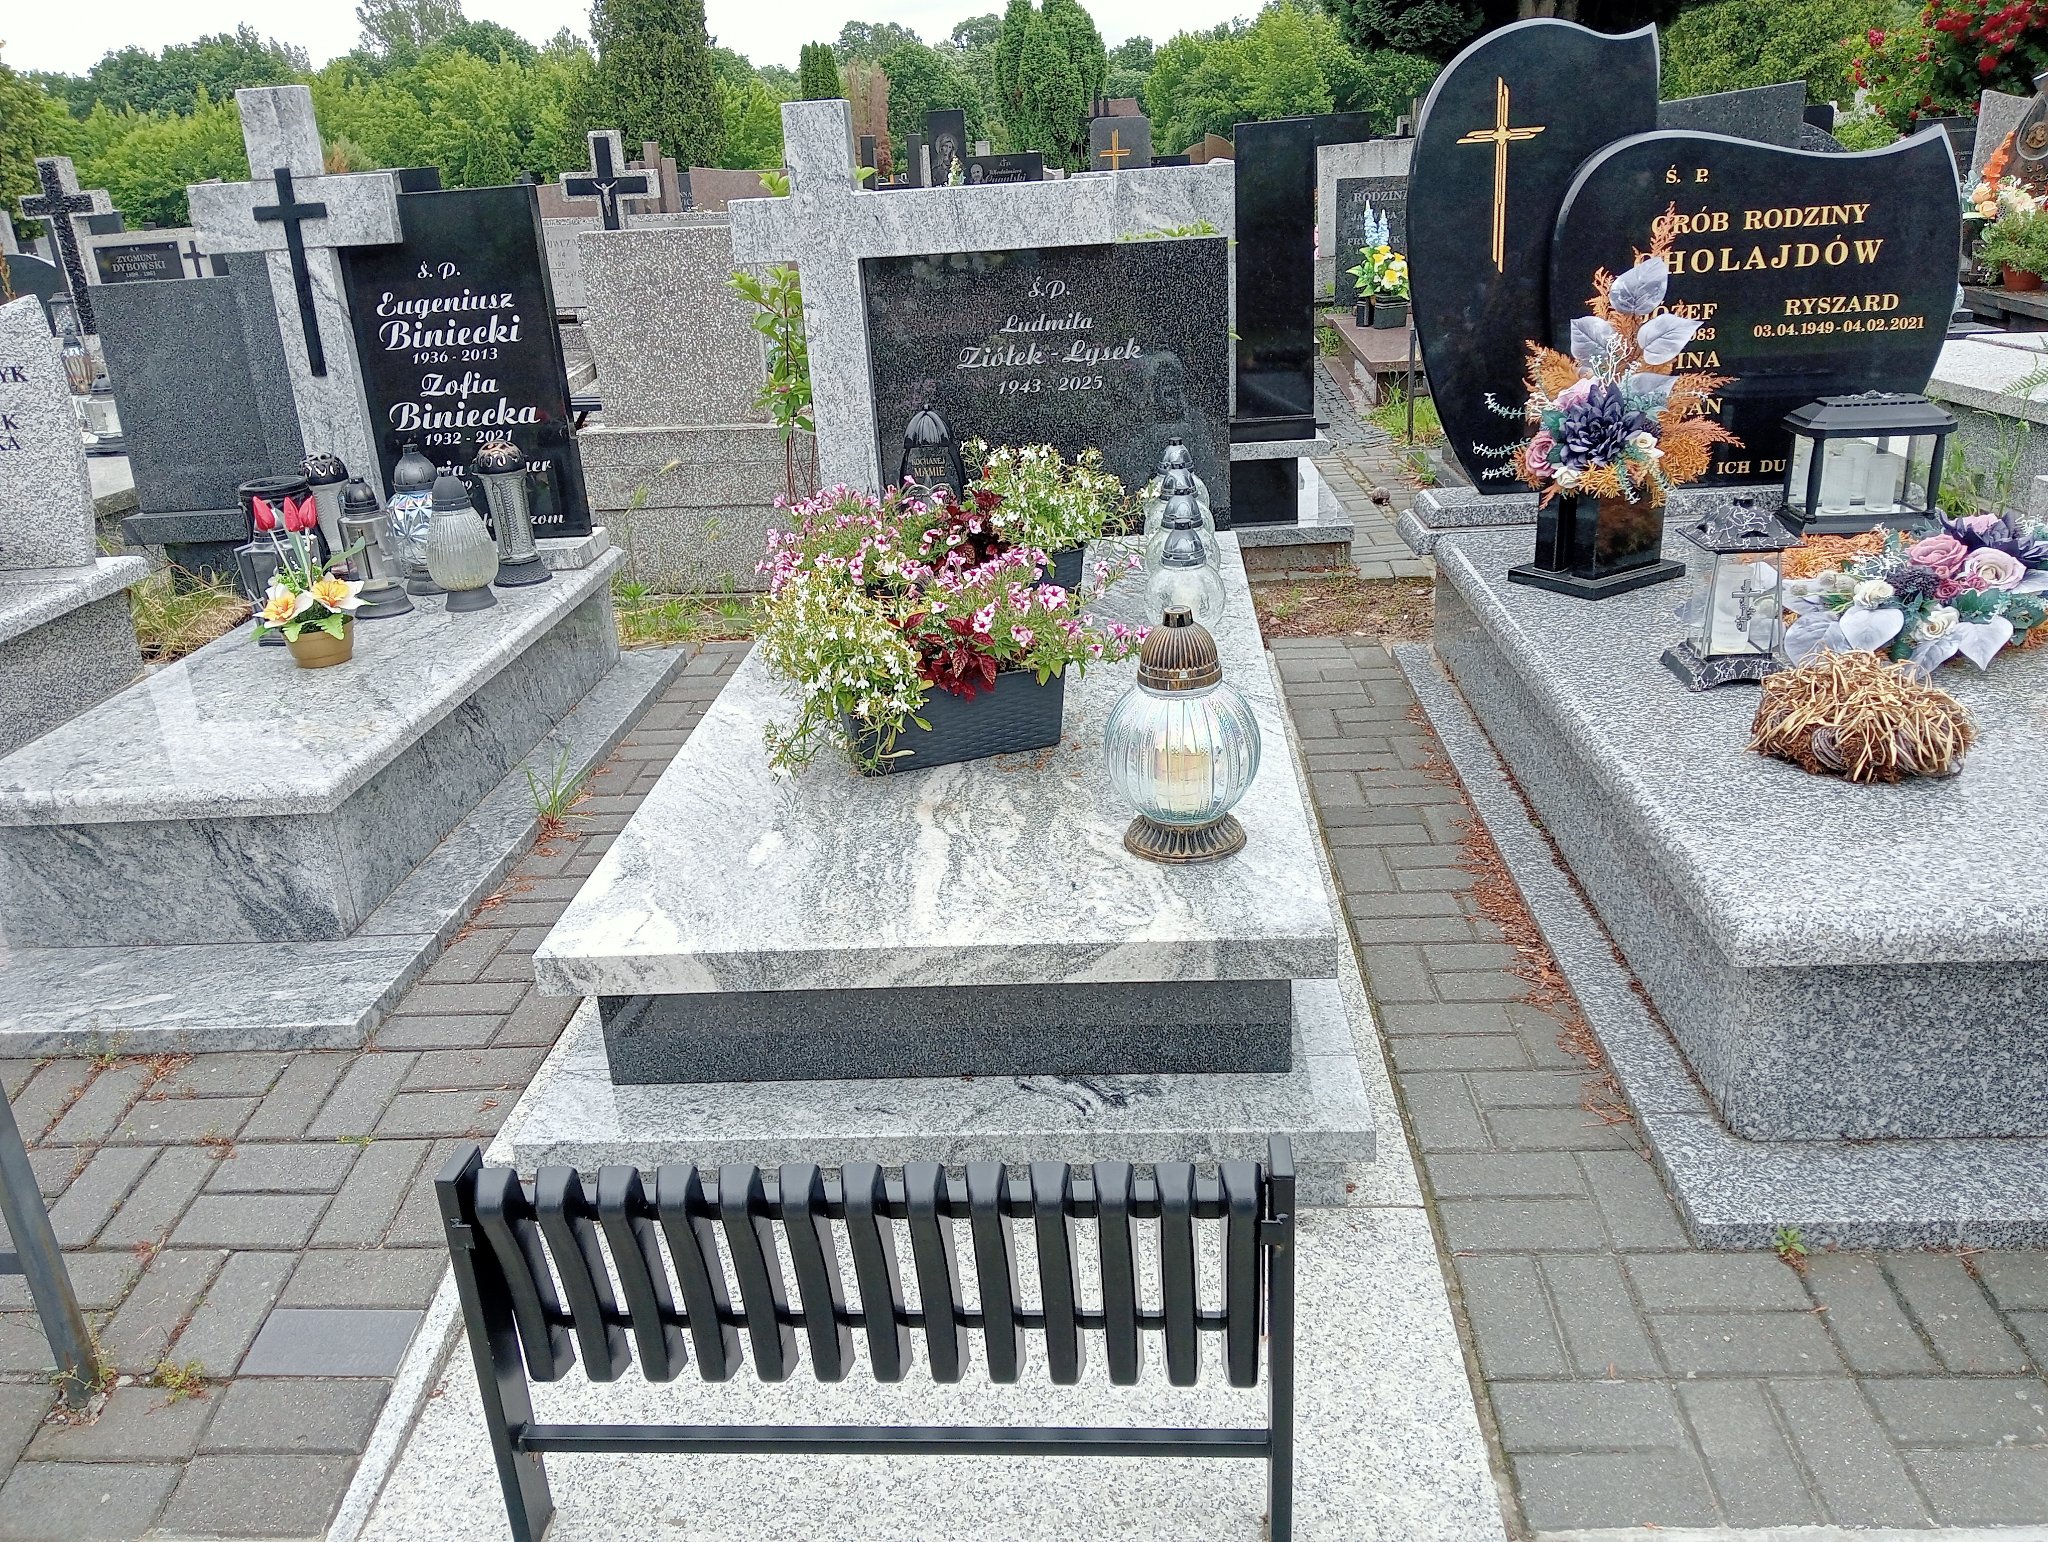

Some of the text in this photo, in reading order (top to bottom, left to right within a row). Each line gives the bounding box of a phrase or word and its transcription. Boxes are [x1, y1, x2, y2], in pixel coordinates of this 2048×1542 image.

[1743, 203, 1871, 231] RODZINY
[112, 260, 167, 273] DYBOWSKI
[116, 253, 158, 263] ZYGMUNT
[376, 288, 516, 320] Eugeniusz
[1783, 293, 1900, 316] RYSZARD
[378, 314, 523, 351] Biniecki
[999, 311, 1095, 334] Ludmiła
[412, 350, 449, 364] 1936
[461, 347, 498, 362] 2013
[956, 342, 1046, 370] Ziółek
[419, 370, 500, 400] Zofia
[998, 378, 1042, 395] 1943
[1058, 375, 1103, 391] 2025
[389, 397, 541, 431] Biniecka
[425, 432, 462, 446] 1932
[475, 429, 513, 443] 2021
[914, 466, 946, 477] MAMIE
[1717, 460, 1751, 475] ICH
